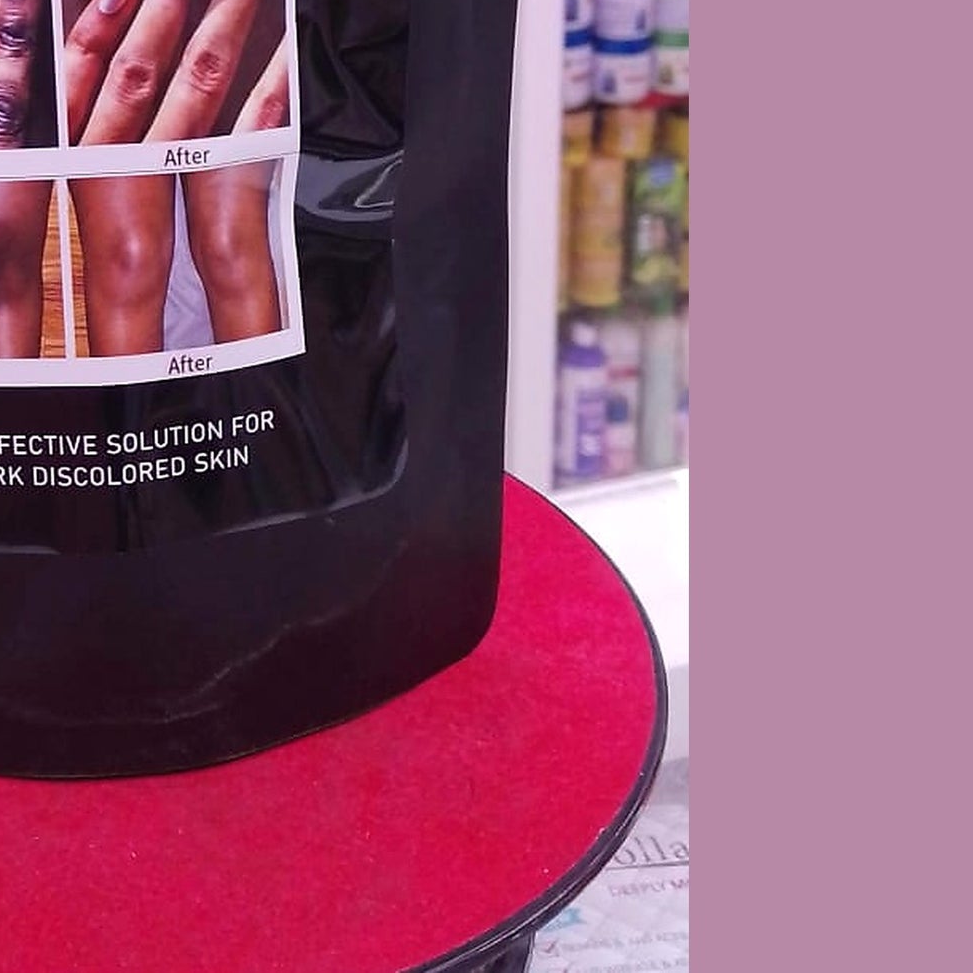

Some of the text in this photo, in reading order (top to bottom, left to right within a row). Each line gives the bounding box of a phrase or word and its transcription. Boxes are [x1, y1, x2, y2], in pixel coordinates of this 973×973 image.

[164, 146, 211, 167] After
[168, 354, 214, 375] After
[106, 418, 224, 455] SOLUTION
[230, 409, 276, 437] FOR
[32, 454, 187, 487] DISCOLORED
[193, 444, 250, 474] SKIN
